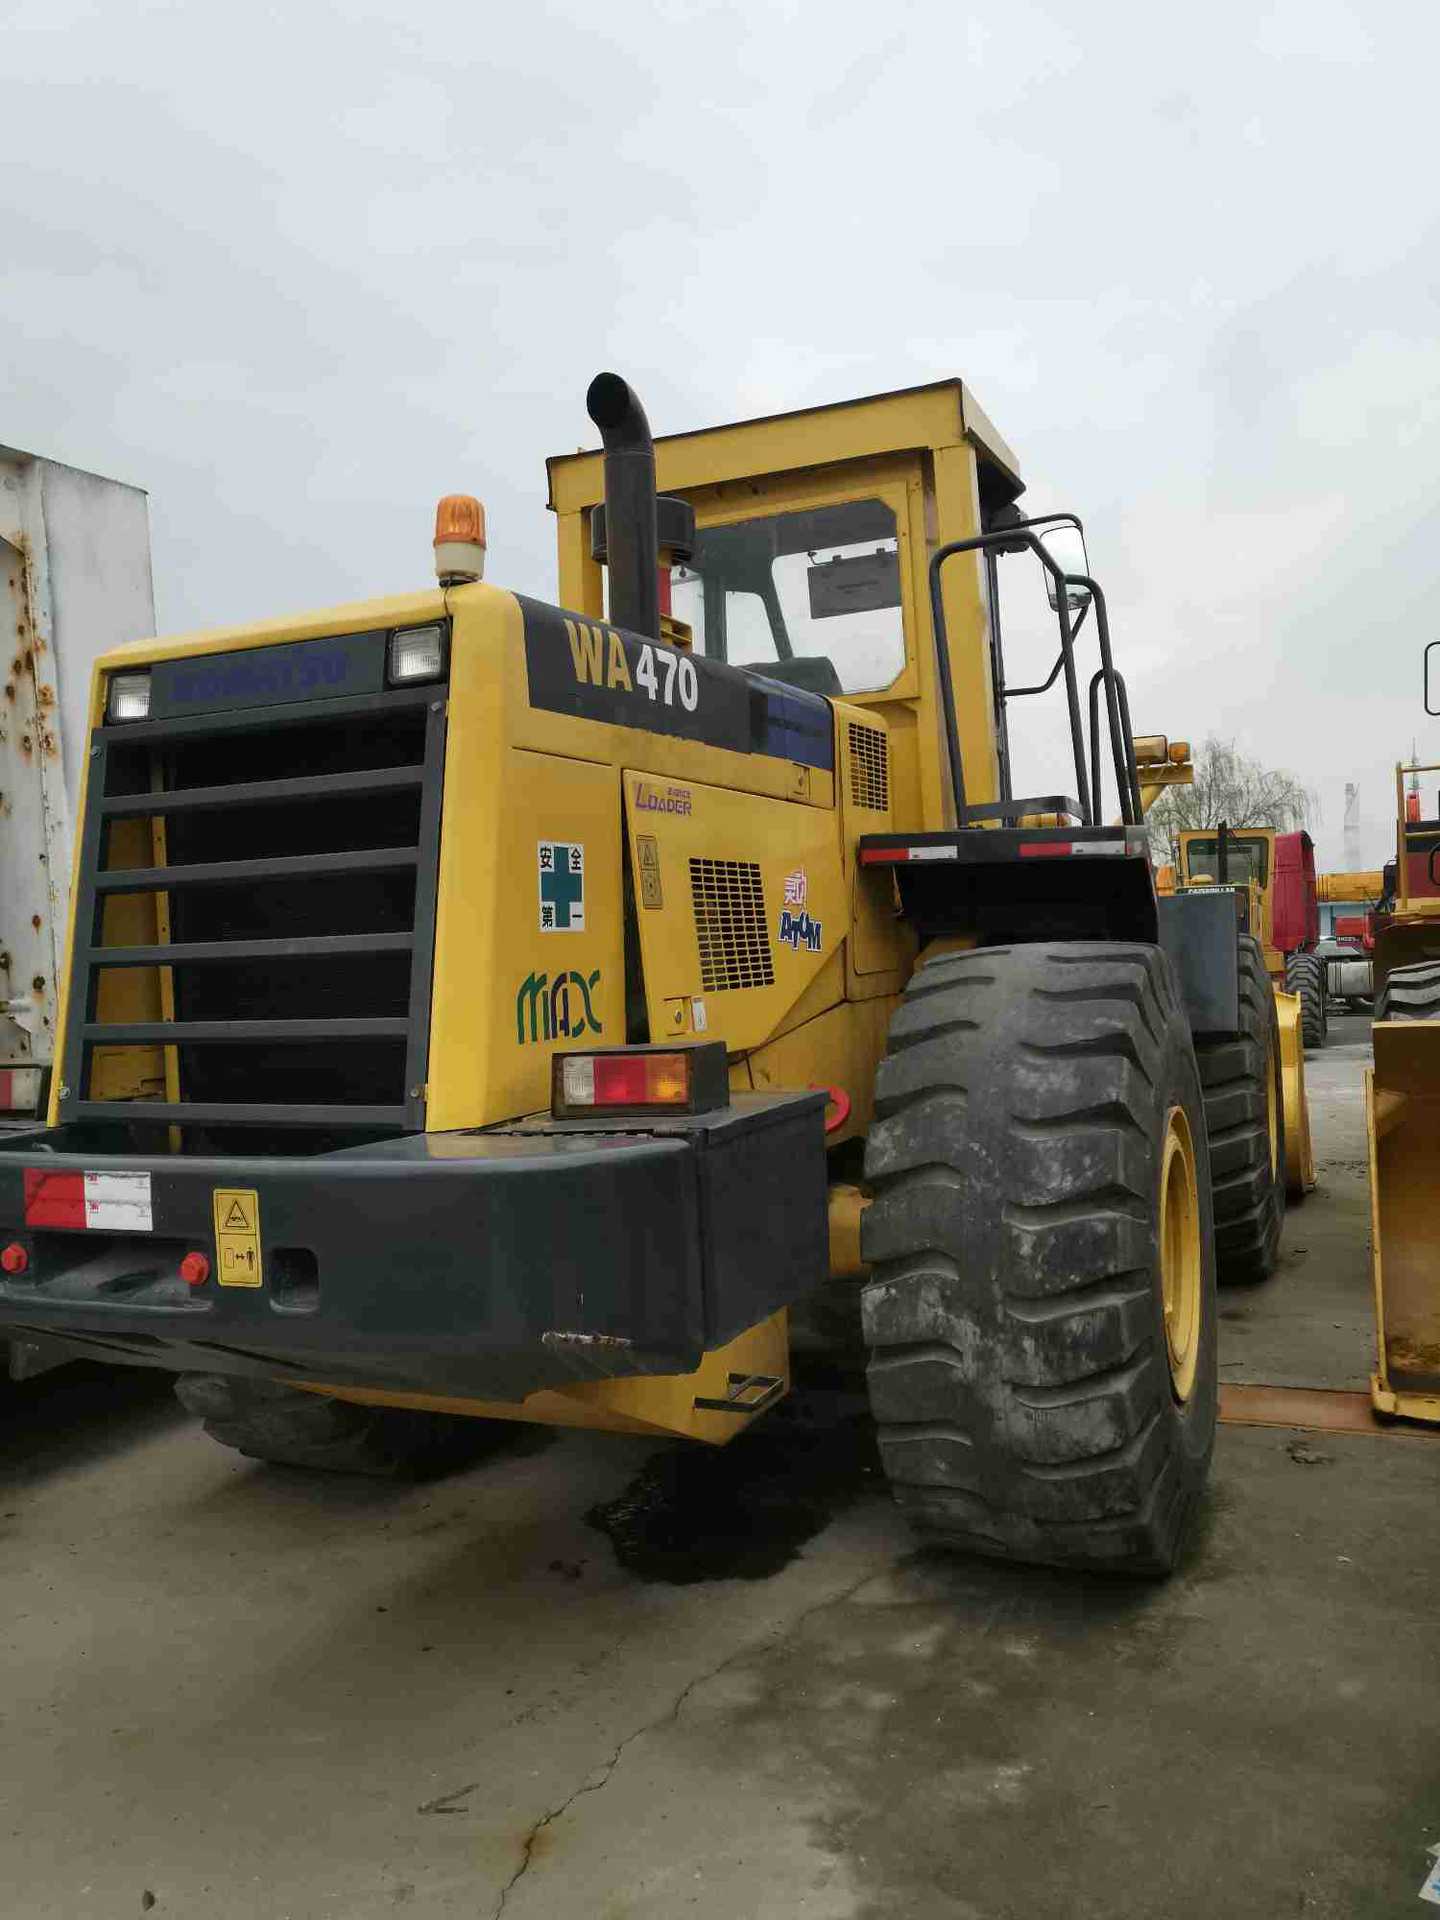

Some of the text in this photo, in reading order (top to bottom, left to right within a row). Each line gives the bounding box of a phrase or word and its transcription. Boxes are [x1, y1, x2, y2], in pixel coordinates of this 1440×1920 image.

[563, 617, 699, 712] WA 470
[635, 783, 692, 816] LOADER
[517, 970, 602, 1045] MAX
